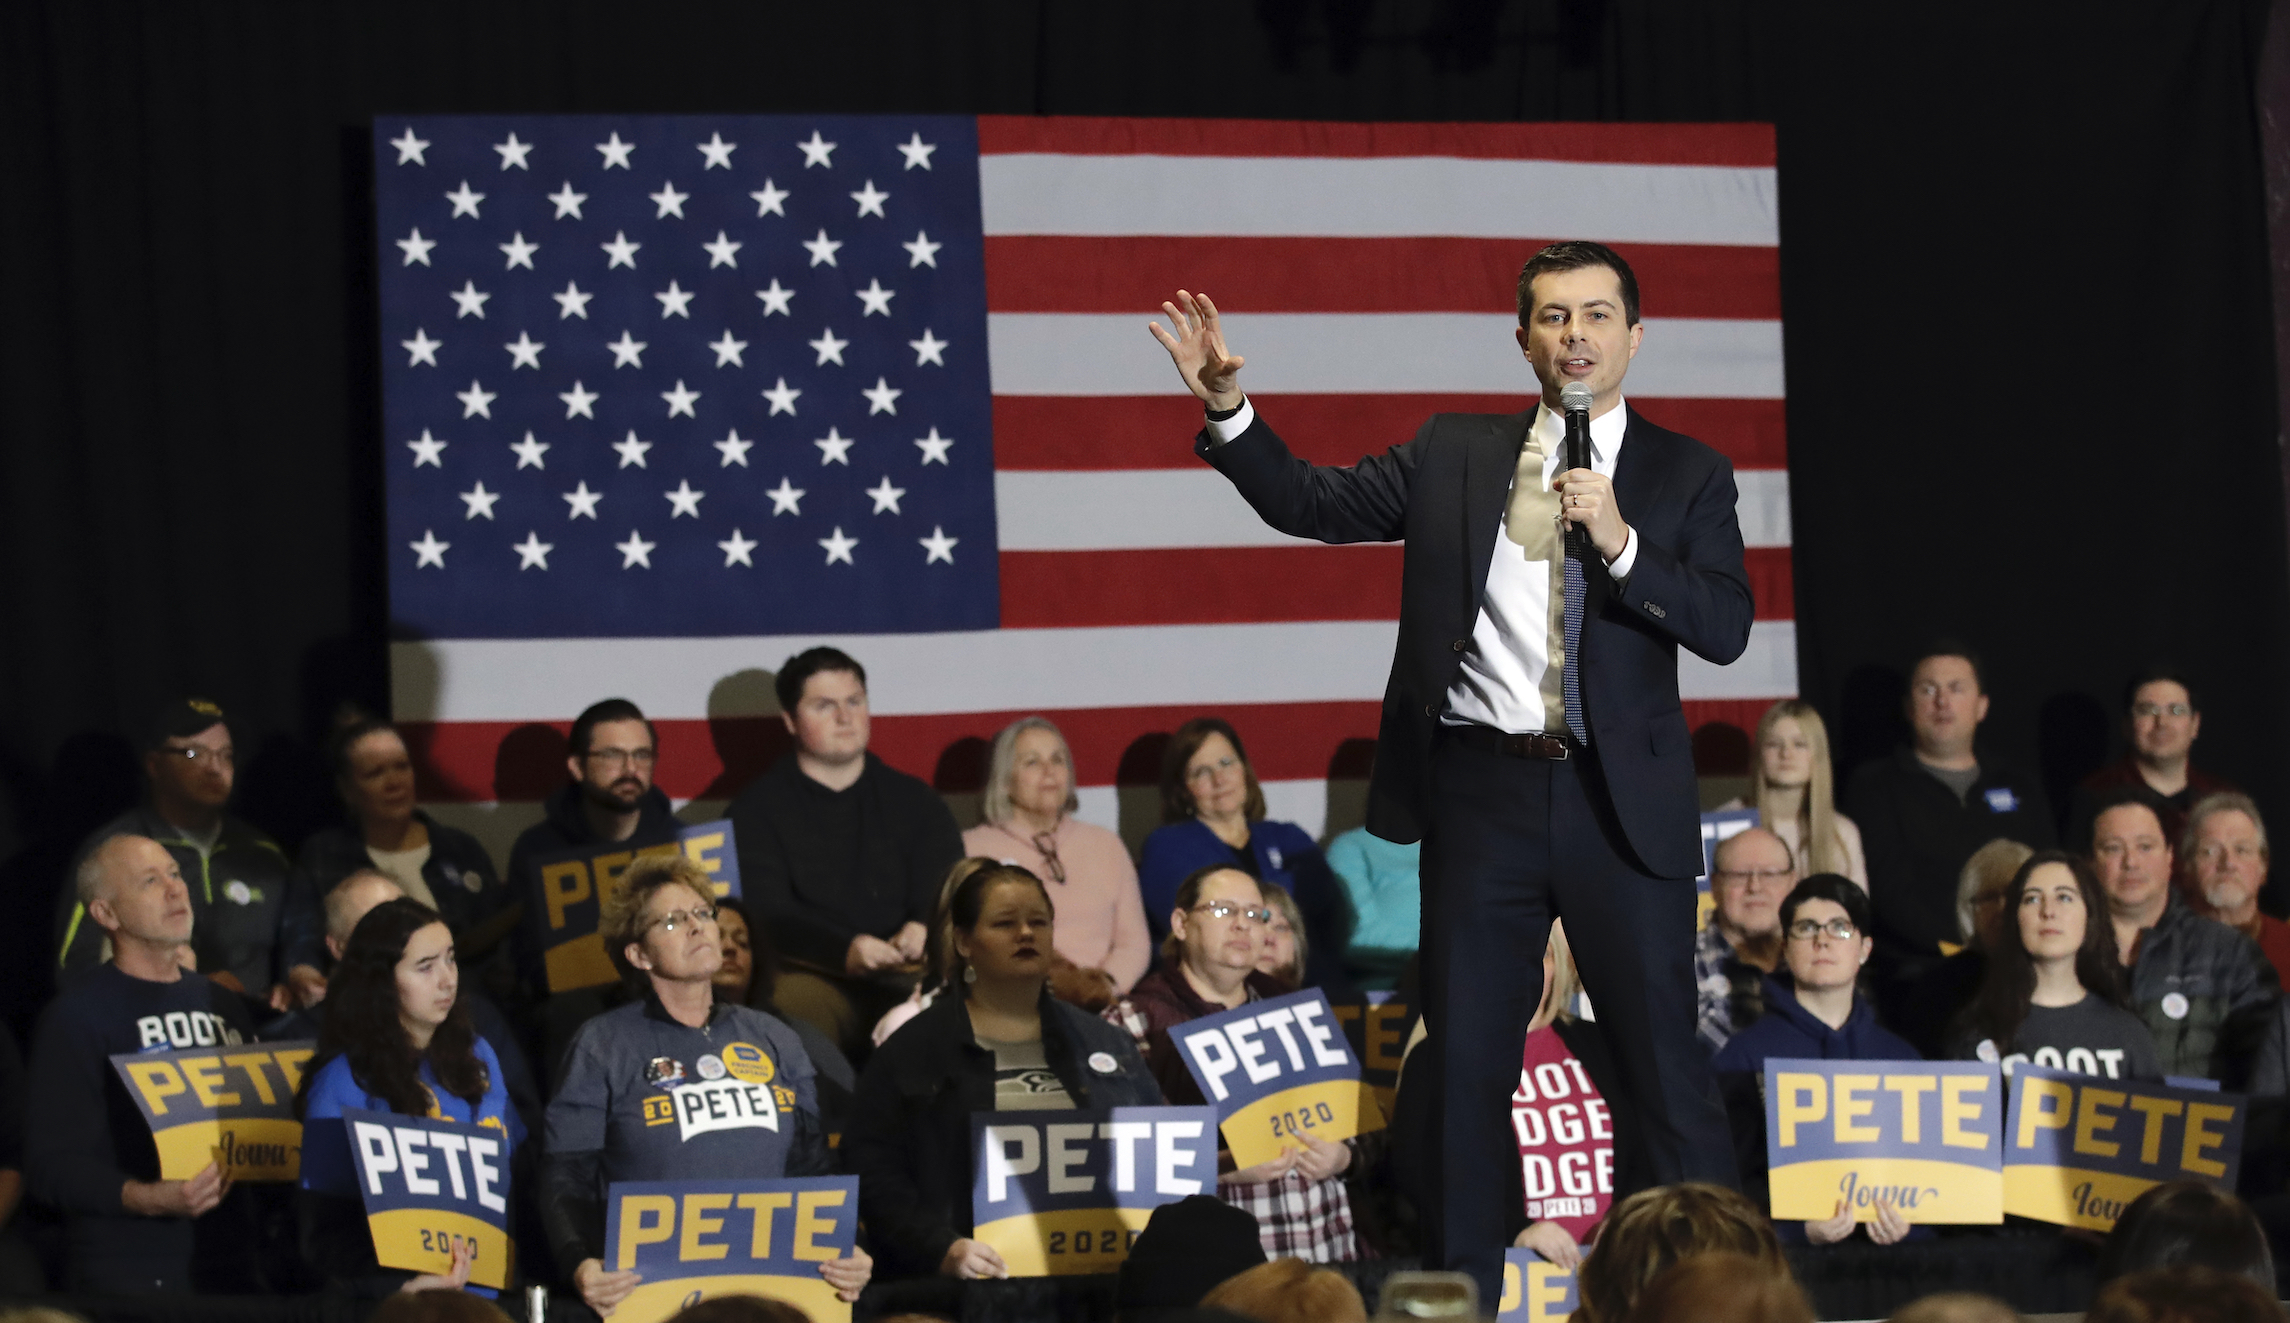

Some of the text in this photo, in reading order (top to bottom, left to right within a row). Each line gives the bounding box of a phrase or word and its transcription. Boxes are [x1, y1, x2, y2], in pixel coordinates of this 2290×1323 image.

[1184, 1000, 1348, 1102] PETE
[682, 1087, 768, 1124] PETE
[1270, 1102, 1333, 1138] 2020
[1777, 1072, 1990, 1150] PETE
[2016, 1076, 2236, 1178] PETE
[354, 1121, 506, 1214] PETE
[985, 1121, 1204, 1203] PETE
[1839, 1171, 1939, 1208] Iowa
[420, 1229, 478, 1260] 200
[617, 1190, 847, 1270] PETE
